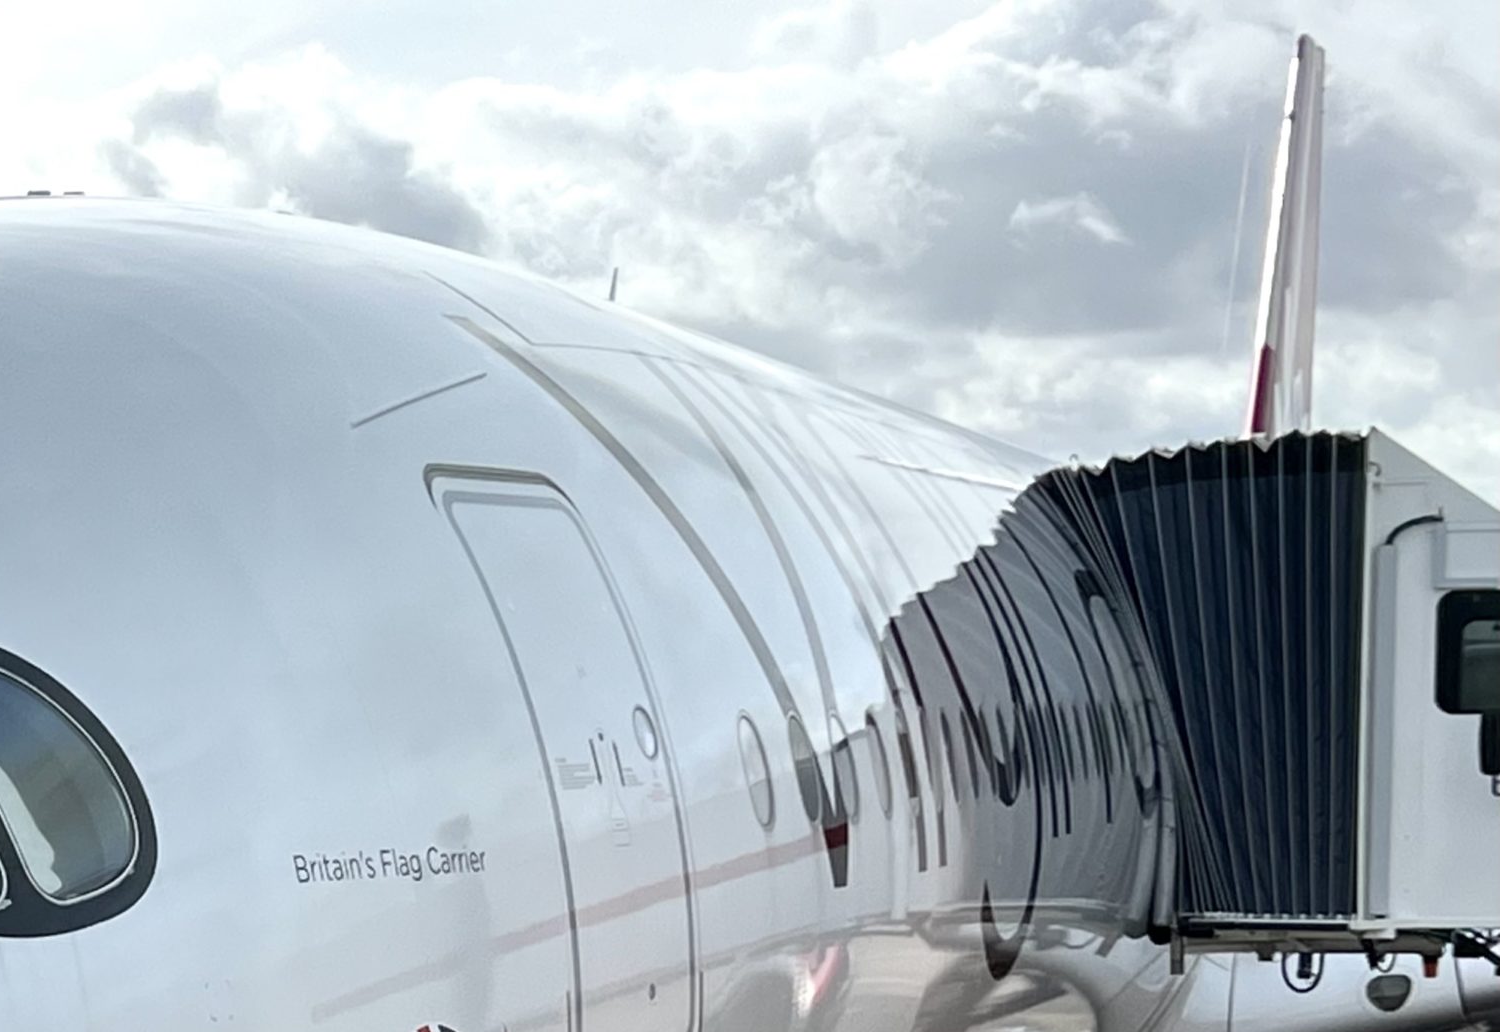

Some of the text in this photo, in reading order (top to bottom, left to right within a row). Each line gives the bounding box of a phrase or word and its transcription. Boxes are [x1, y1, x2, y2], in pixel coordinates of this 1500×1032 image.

[293, 845, 486, 883] Britain's Flag Carrier
